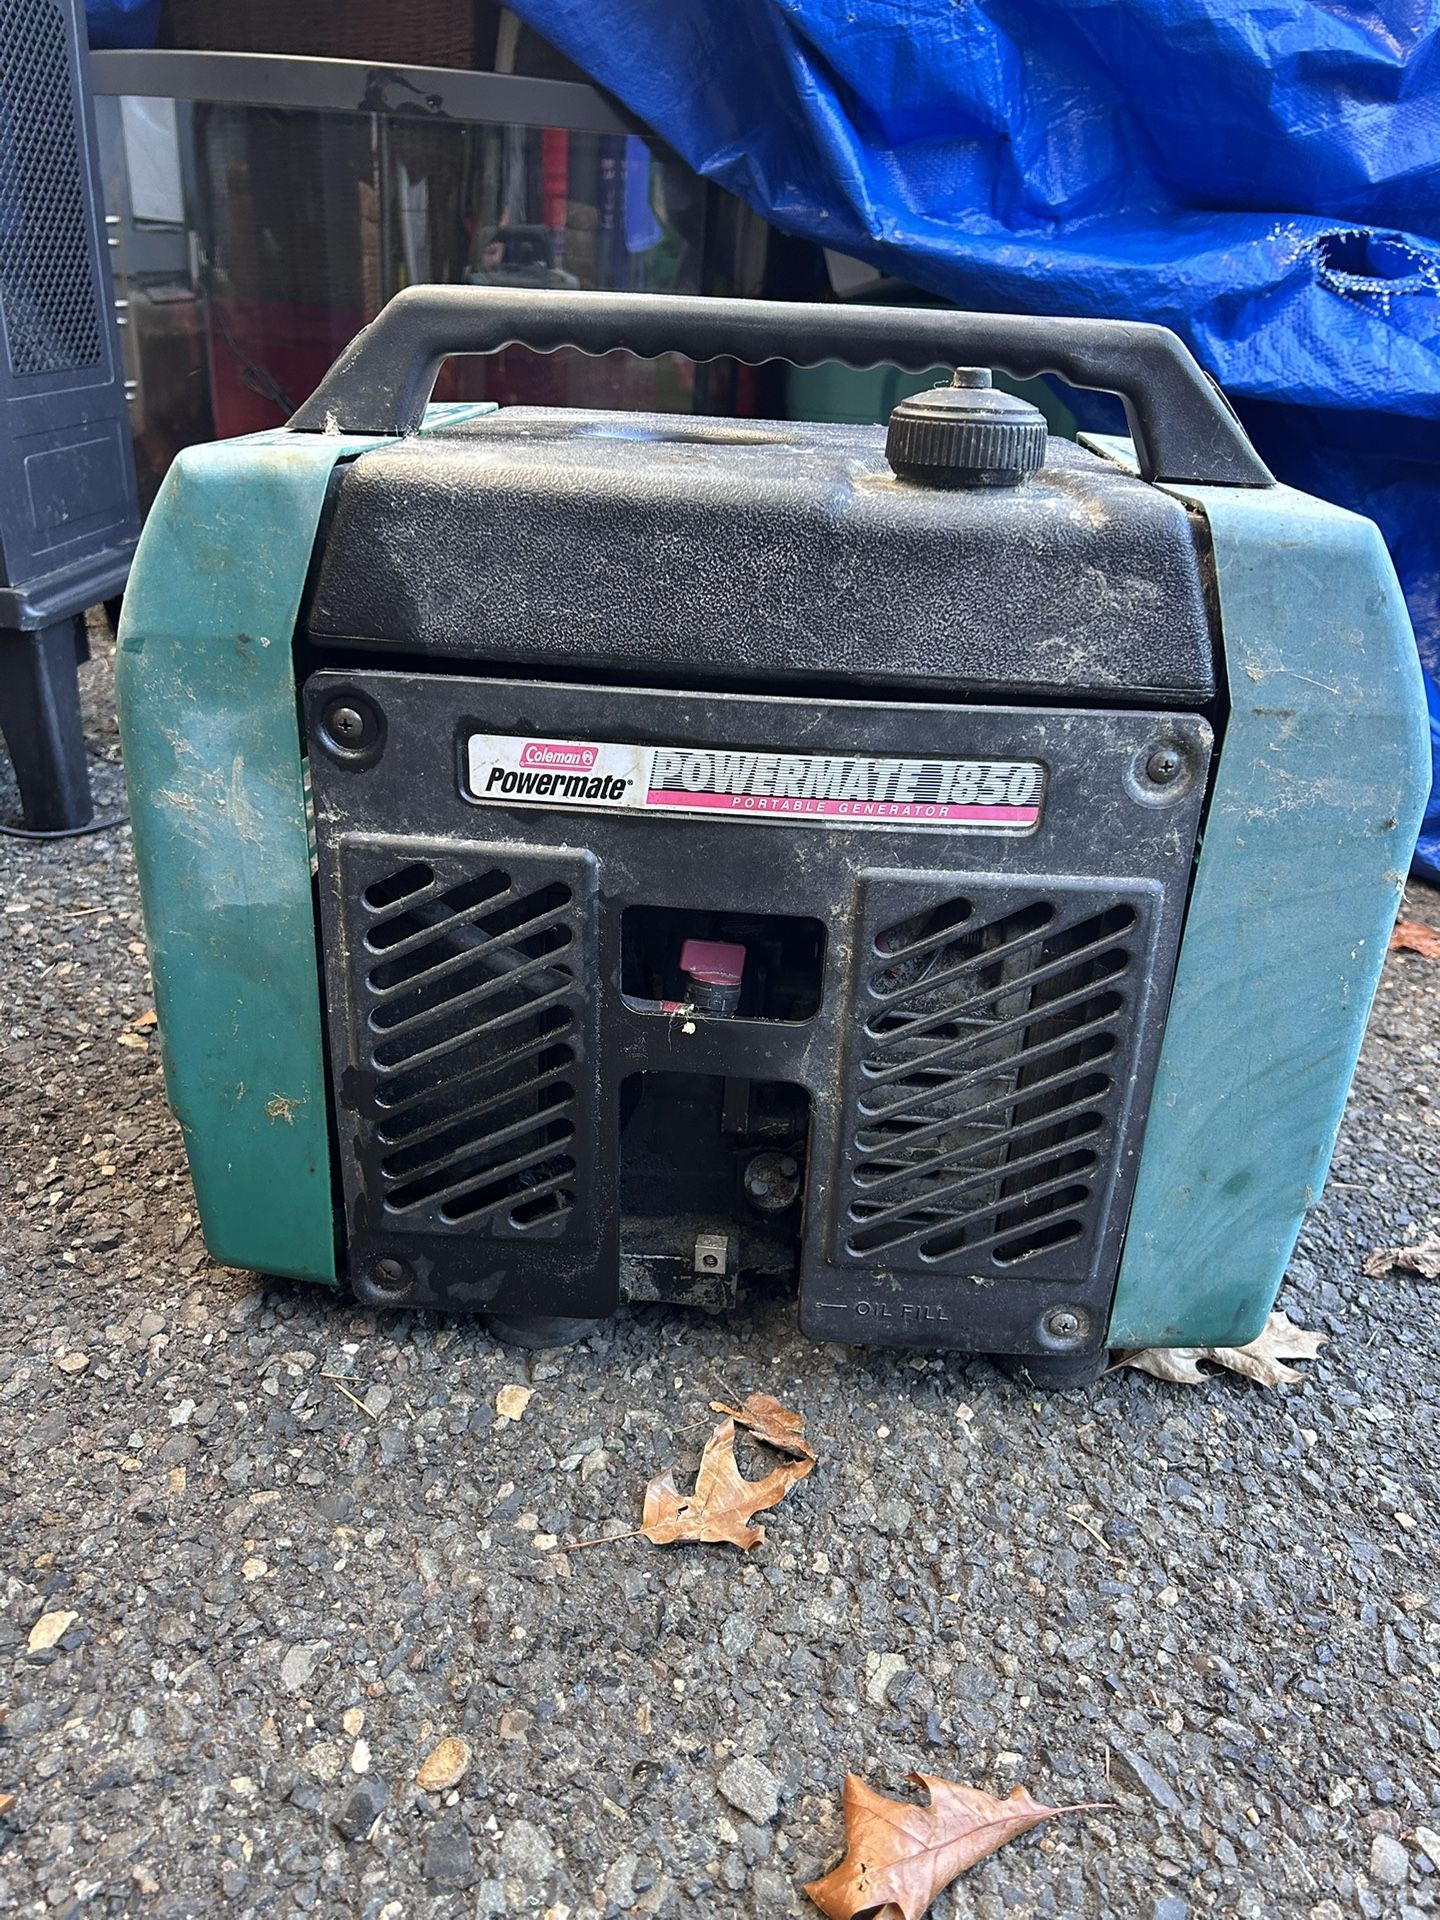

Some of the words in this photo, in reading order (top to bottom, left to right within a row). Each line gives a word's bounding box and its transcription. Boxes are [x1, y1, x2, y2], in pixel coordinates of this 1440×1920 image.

[524, 745, 581, 764] Coleman
[485, 767, 626, 800] Powermate
[654, 751, 925, 803] POWERMATE
[936, 764, 1035, 806] 1850
[731, 797, 827, 813] PORTABLE
[838, 802, 951, 818] GENERATOR
[856, 1301, 893, 1317] OIL
[901, 1303, 949, 1320] FILL
